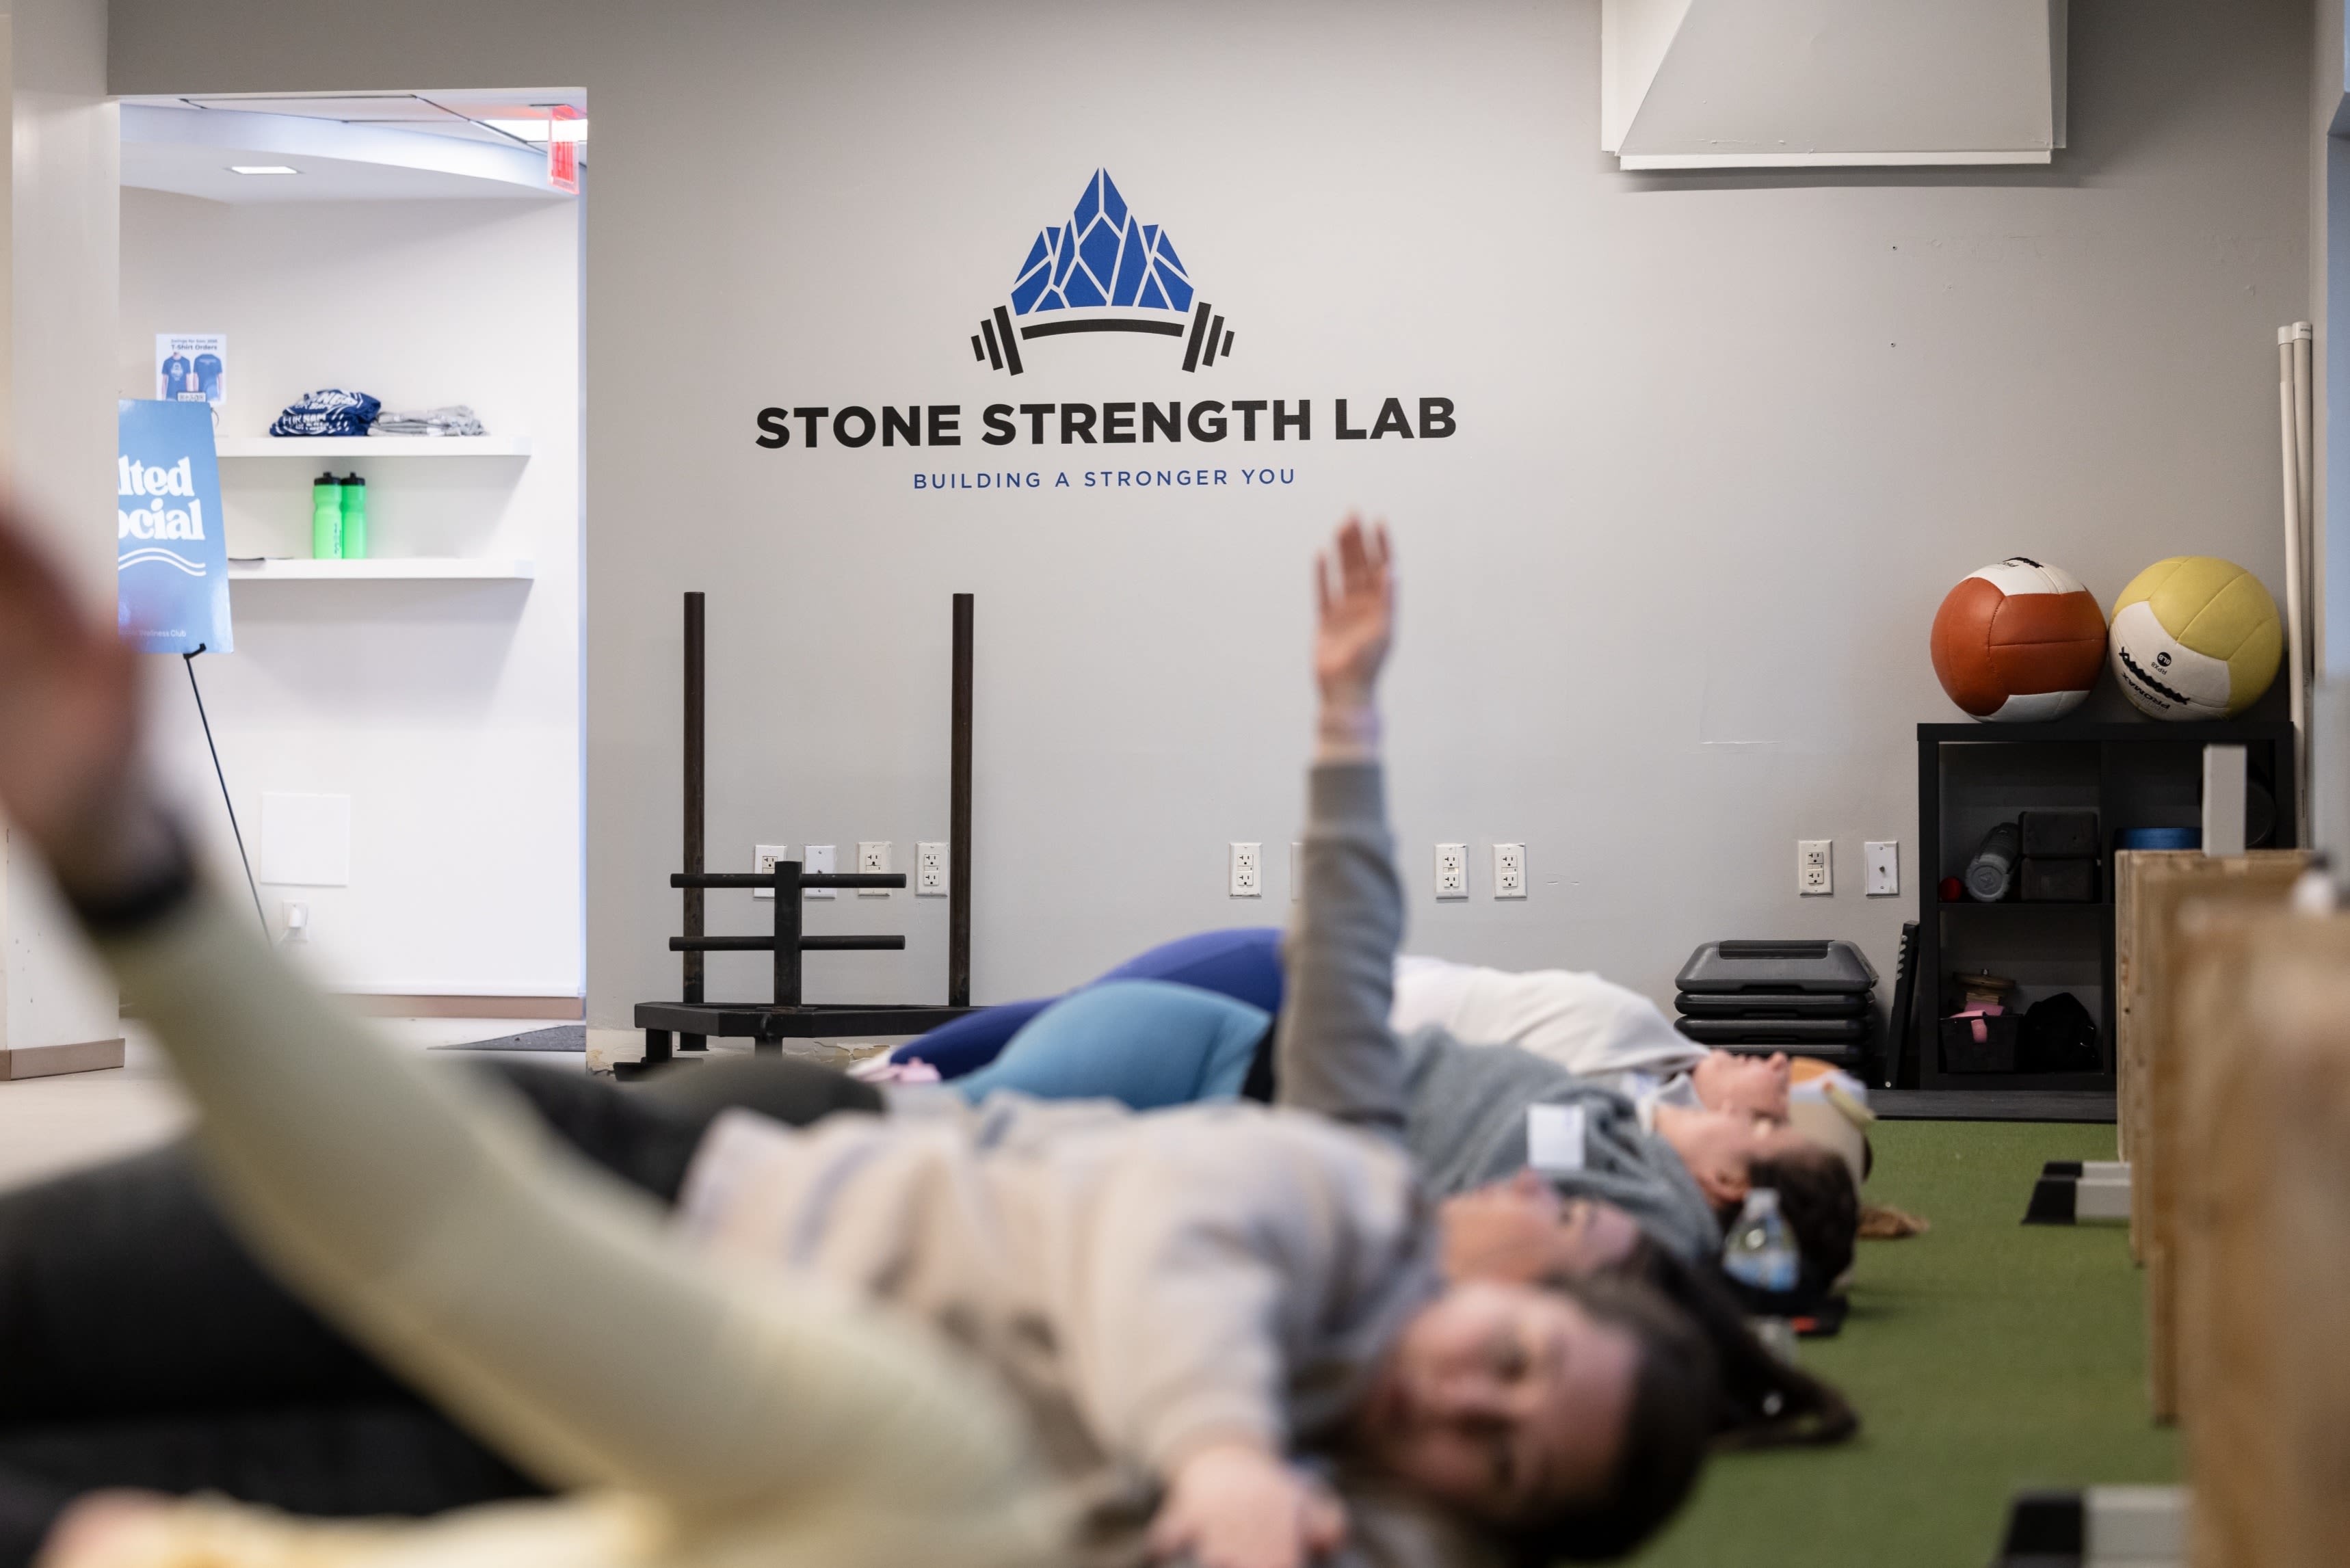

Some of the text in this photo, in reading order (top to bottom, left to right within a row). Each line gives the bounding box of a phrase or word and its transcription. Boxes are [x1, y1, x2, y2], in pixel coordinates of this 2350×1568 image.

[755, 397, 1457, 449] STONE STRENGTH LAB
[914, 468, 1295, 488] BUILDING A STRONGER YOU
[170, 629, 187, 637] Club
[2122, 671, 2171, 709] PROMAX
